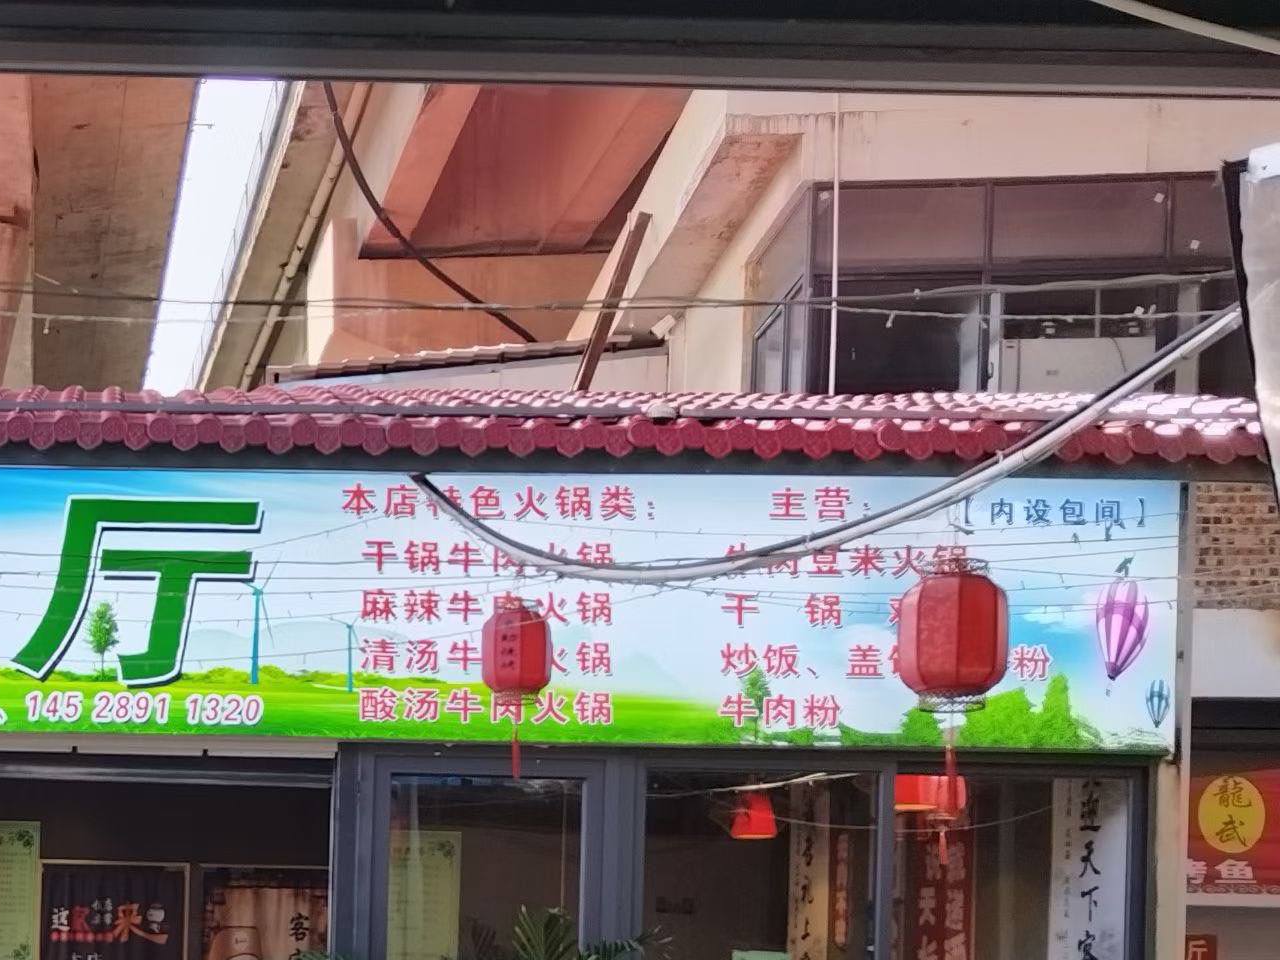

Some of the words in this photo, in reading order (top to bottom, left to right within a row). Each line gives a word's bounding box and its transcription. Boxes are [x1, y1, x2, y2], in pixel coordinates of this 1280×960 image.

[360, 638, 611, 674] 清汤牛锅
[26, 692, 82, 721] 145
[95, 693, 169, 723] 2891
[186, 695, 262, 725] 1320
[720, 695, 841, 728] 牛肉粉
